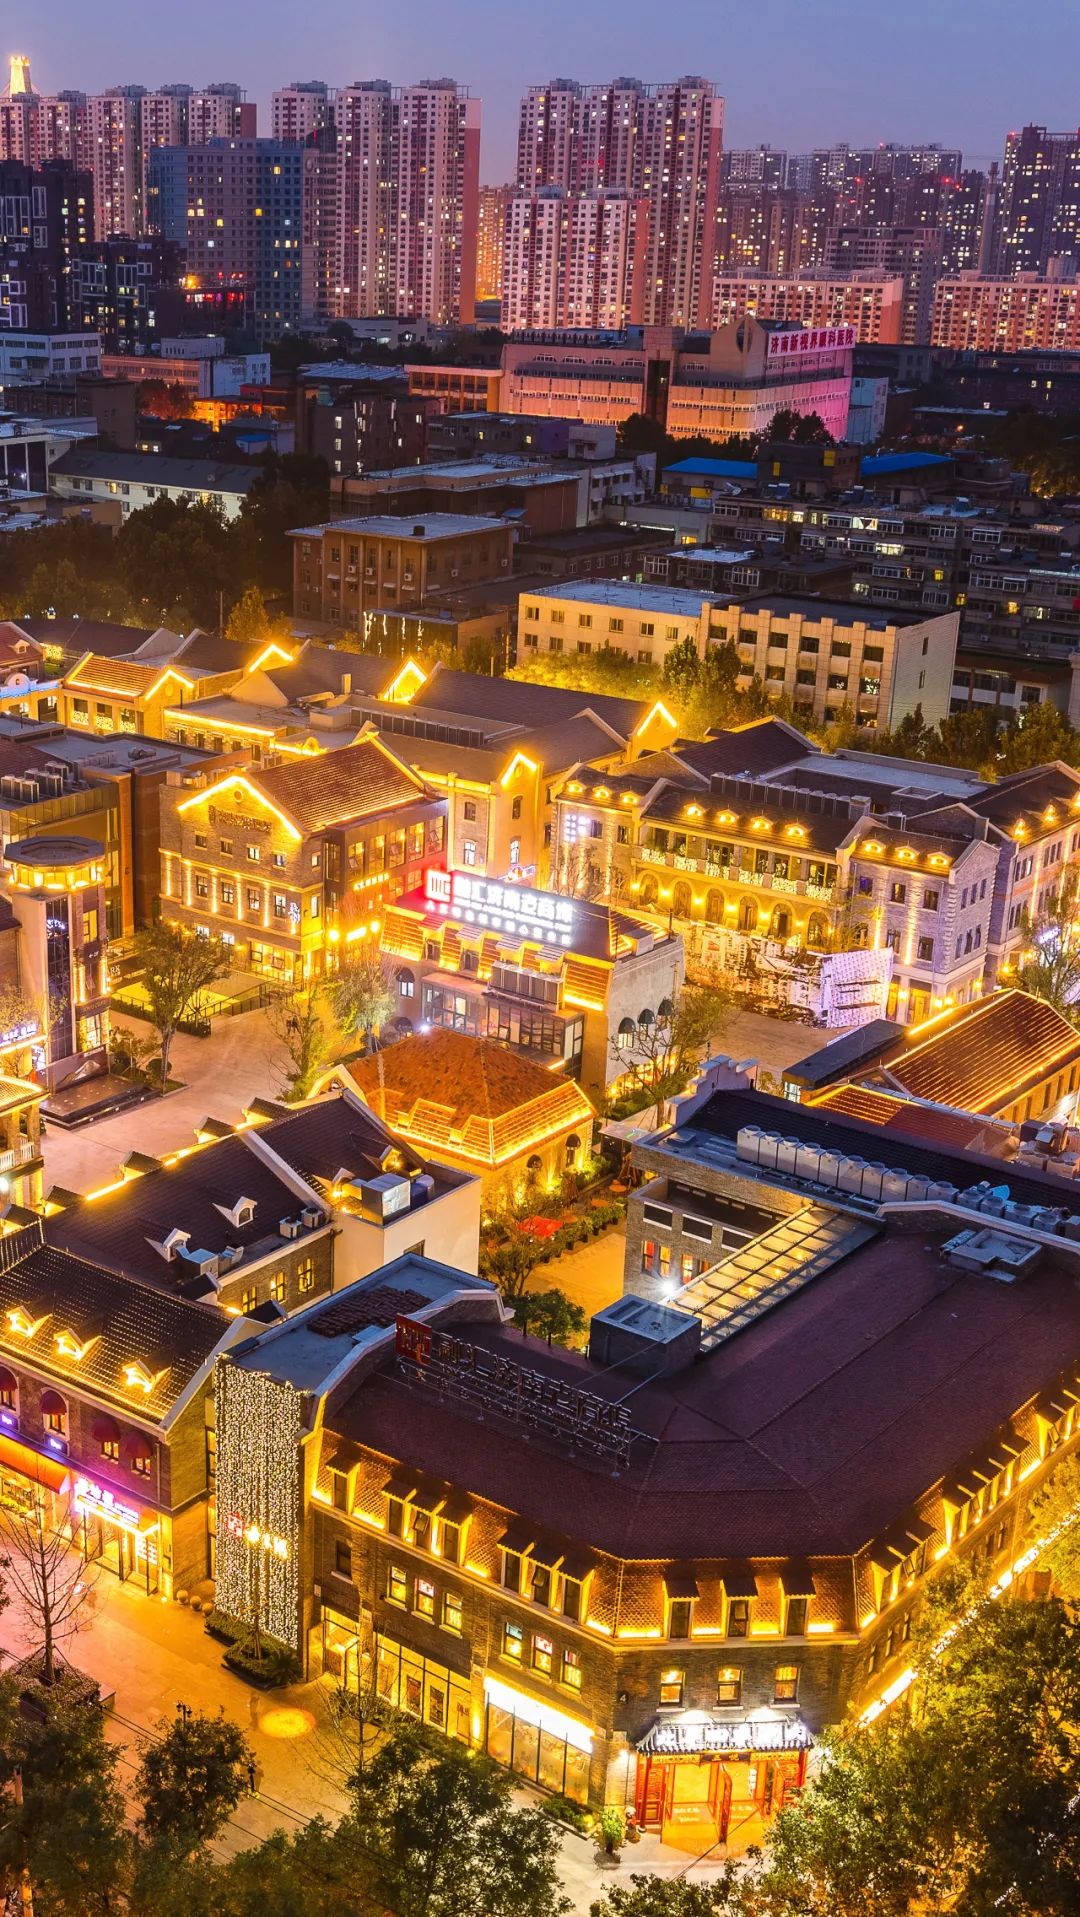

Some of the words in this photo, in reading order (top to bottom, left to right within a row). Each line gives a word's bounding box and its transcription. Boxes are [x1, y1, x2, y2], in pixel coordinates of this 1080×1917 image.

[771, 329, 854, 354] 济南新视界眼科医院
